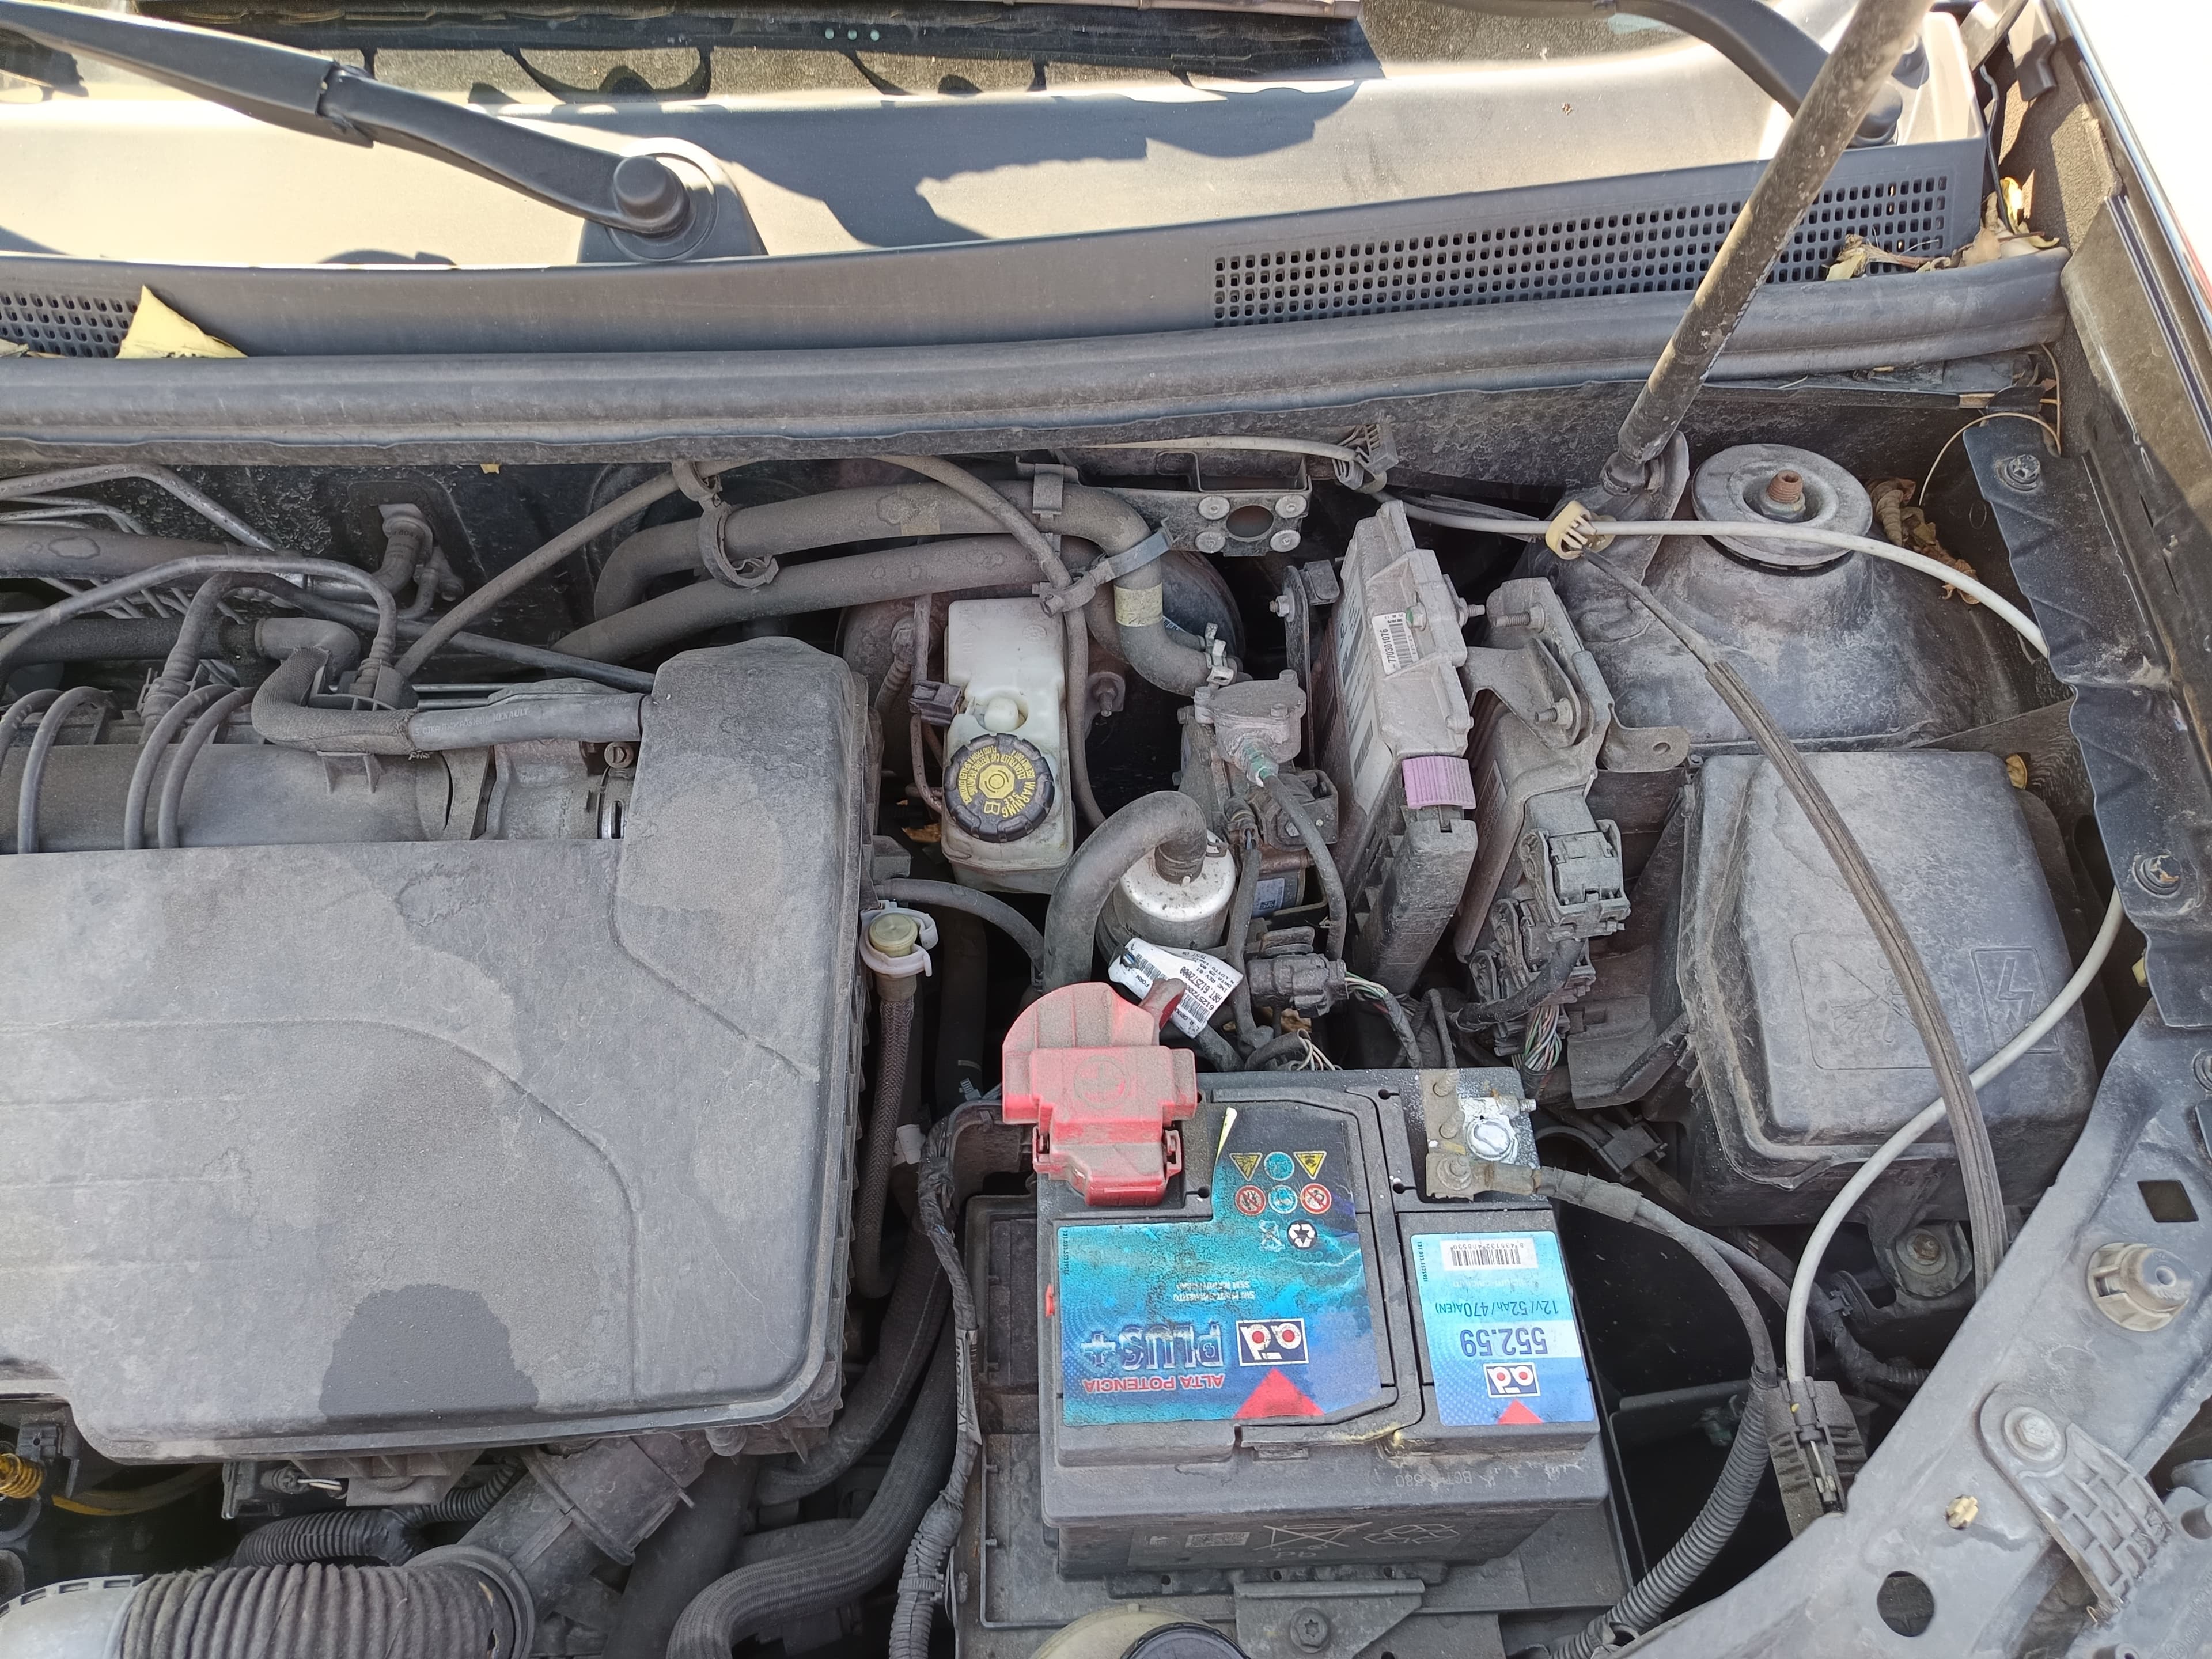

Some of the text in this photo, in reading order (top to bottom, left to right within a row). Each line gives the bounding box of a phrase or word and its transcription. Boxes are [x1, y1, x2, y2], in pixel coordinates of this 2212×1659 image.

[990, 753, 1000, 762] CAP
[1002, 782, 1035, 817] WARNING
[1003, 792, 1018, 807] SEE
[1119, 1321, 1225, 1370] PLUS
[1460, 1327, 1548, 1357] 552.59
[1082, 1374, 1225, 1393] ALTA POTENCIA
